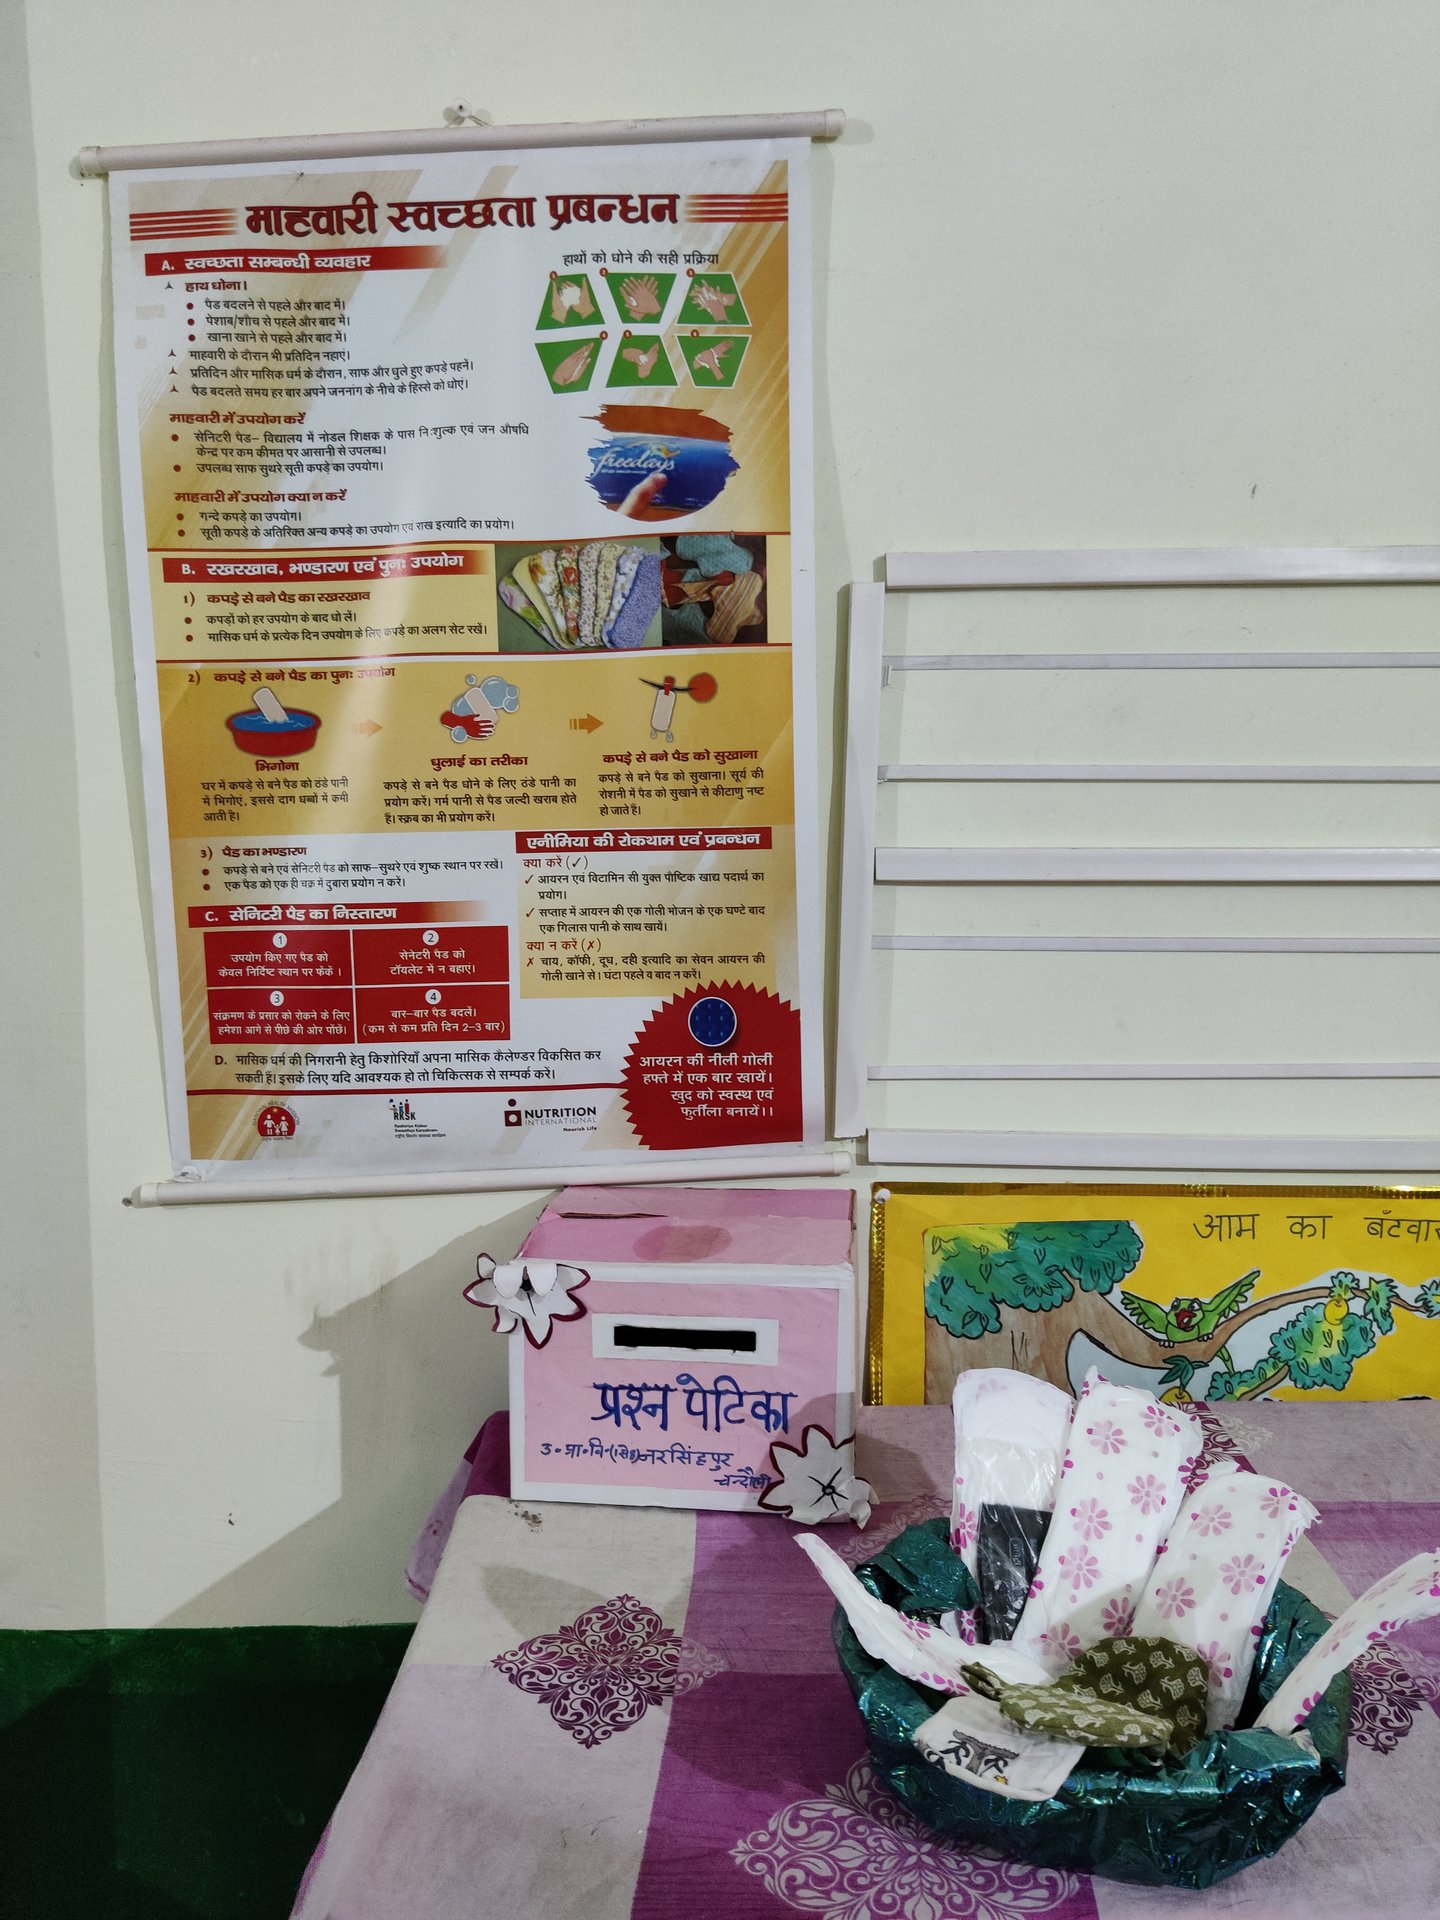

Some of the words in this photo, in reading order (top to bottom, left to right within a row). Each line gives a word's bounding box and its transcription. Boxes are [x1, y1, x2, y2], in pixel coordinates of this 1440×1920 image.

[245, 191, 378, 237] माहवारी
[387, 197, 537, 233] स्वच्छता
[545, 194, 680, 231] प्रबन्धन
[161, 260, 175, 271] A.
[184, 257, 244, 270] स्वच्छता
[248, 253, 310, 269] सम्बन्धी
[314, 255, 372, 269] व्यवहार
[562, 250, 587, 267] हाथों
[591, 249, 606, 263] को
[611, 249, 633, 263] धोने
[637, 249, 653, 264] की
[656, 250, 679, 265] सही
[683, 250, 719, 265] प्रक्रिया
[185, 282, 209, 292] हाथ
[211, 278, 247, 290] धोना।
[204, 297, 221, 309] पैड
[222, 297, 254, 310] बदलने
[256, 298, 266, 310] से
[268, 298, 291, 312] पहले
[293, 299, 312, 311] और
[313, 301, 331, 311] बाद
[332, 298, 345, 310] में।
[188, 347, 226, 361] माहवारी
[228, 347, 239, 360] के
[240, 348, 269, 361] दौरान
[271, 348, 282, 361] भी
[283, 349, 320, 362] प्रतिदिन
[322, 348, 350, 362] नहाएं।
[169, 410, 221, 424] माहवारी
[222, 411, 239, 424] में
[235, 411, 282, 424] उपयोग
[283, 412, 306, 424] करें
[193, 429, 231, 443] सेनिटरी
[263, 431, 303, 443] विद्यालय
[306, 430, 314, 443] में
[317, 430, 346, 442] नोडल
[349, 429, 380, 441] शिक्षक
[383, 428, 394, 440] के
[397, 430, 415, 439] पास
[459, 422, 474, 436] एवं
[477, 425, 495, 434] जन
[499, 422, 529, 435] औषधि
[199, 509, 220, 522] गन्दे
[221, 509, 247, 524] कपड़े
[248, 513, 262, 521] का
[264, 509, 301, 521] उपयोग।
[182, 564, 195, 574] B.
[206, 564, 283, 576] रखरखाव,
[289, 562, 349, 575] भण्डारण
[353, 557, 377, 573] एवं
[410, 552, 464, 568] उपयोग
[183, 591, 195, 607] 1)
[207, 591, 240, 606] कपड़े
[241, 591, 254, 603] से
[256, 591, 276, 603] बने
[277, 591, 296, 603] पैड
[298, 593, 316, 603] का
[317, 592, 370, 603] रखरखाव
[255, 759, 300, 771] भिगोना
[431, 754, 466, 772] धुलाई
[469, 757, 487, 766] का
[490, 753, 528, 766] तरीका
[602, 751, 632, 766] कपड़े
[635, 751, 647, 763] से
[649, 750, 669, 762] बने
[671, 749, 690, 762] पैड
[693, 749, 711, 761] को
[713, 750, 758, 765] सुखाना
[203, 809, 227, 821] आती
[526, 833, 589, 849] एनीमिया
[593, 832, 614, 847] की
[618, 832, 675, 846] रोकथाम
[678, 831, 703, 846] एवं
[704, 834, 761, 847] प्रबन्धन
[199, 846, 213, 861] 3)
[222, 845, 241, 858] पैड
[242, 848, 260, 856] का
[262, 847, 307, 857] भण्डारण
[205, 911, 218, 921] C.
[229, 905, 283, 921] सेनिटरी
[285, 905, 306, 921] पैड
[309, 909, 329, 919] का
[332, 905, 397, 919] निस्तारण
[434, 948, 449, 959] पैड
[452, 948, 465, 959] को
[426, 963, 434, 974] में
[437, 965, 445, 973] न
[431, 1007, 447, 1017] पैड
[388, 1022, 397, 1033] से
[400, 1024, 417, 1032] कम
[420, 1021, 438, 1032] प्रति
[441, 1020, 459, 1032] दिन
[215, 1055, 227, 1065] D.
[235, 1052, 268, 1065] मासिक
[270, 1052, 286, 1066] धर्म
[287, 1052, 302, 1066] की
[304, 1052, 347, 1066] निगरानी
[349, 1052, 366, 1069] हेतु
[422, 1053, 451, 1063] अपना
[454, 1049, 490, 1062] मासिक
[537, 1048, 581, 1061] विकसित
[583, 1051, 601, 1060] कर
[639, 1056, 683, 1067] आयरन
[686, 1053, 705, 1066] की
[707, 1053, 739, 1066] नीली
[742, 1052, 774, 1065] गोली
[672, 1070, 683, 1083] में
[687, 1073, 708, 1084] एक
[711, 1073, 733, 1083] बार
[736, 1069, 772, 1083] खायें।
[670, 1091, 693, 1104] खुद
[696, 1087, 714, 1100] को
[717, 1090, 753, 1100] स्वस्थ
[756, 1087, 774, 1101] एवं
[393, 1112, 416, 1121] RKSK
[525, 1107, 596, 1118] NUTRITION
[525, 1117, 596, 1126] INTERNATIONAL
[1193, 1212, 1260, 1242] आम
[1287, 1214, 1333, 1240] का
[589, 1380, 676, 1432] प्रश्न
[675, 1372, 798, 1435] पेटिका
